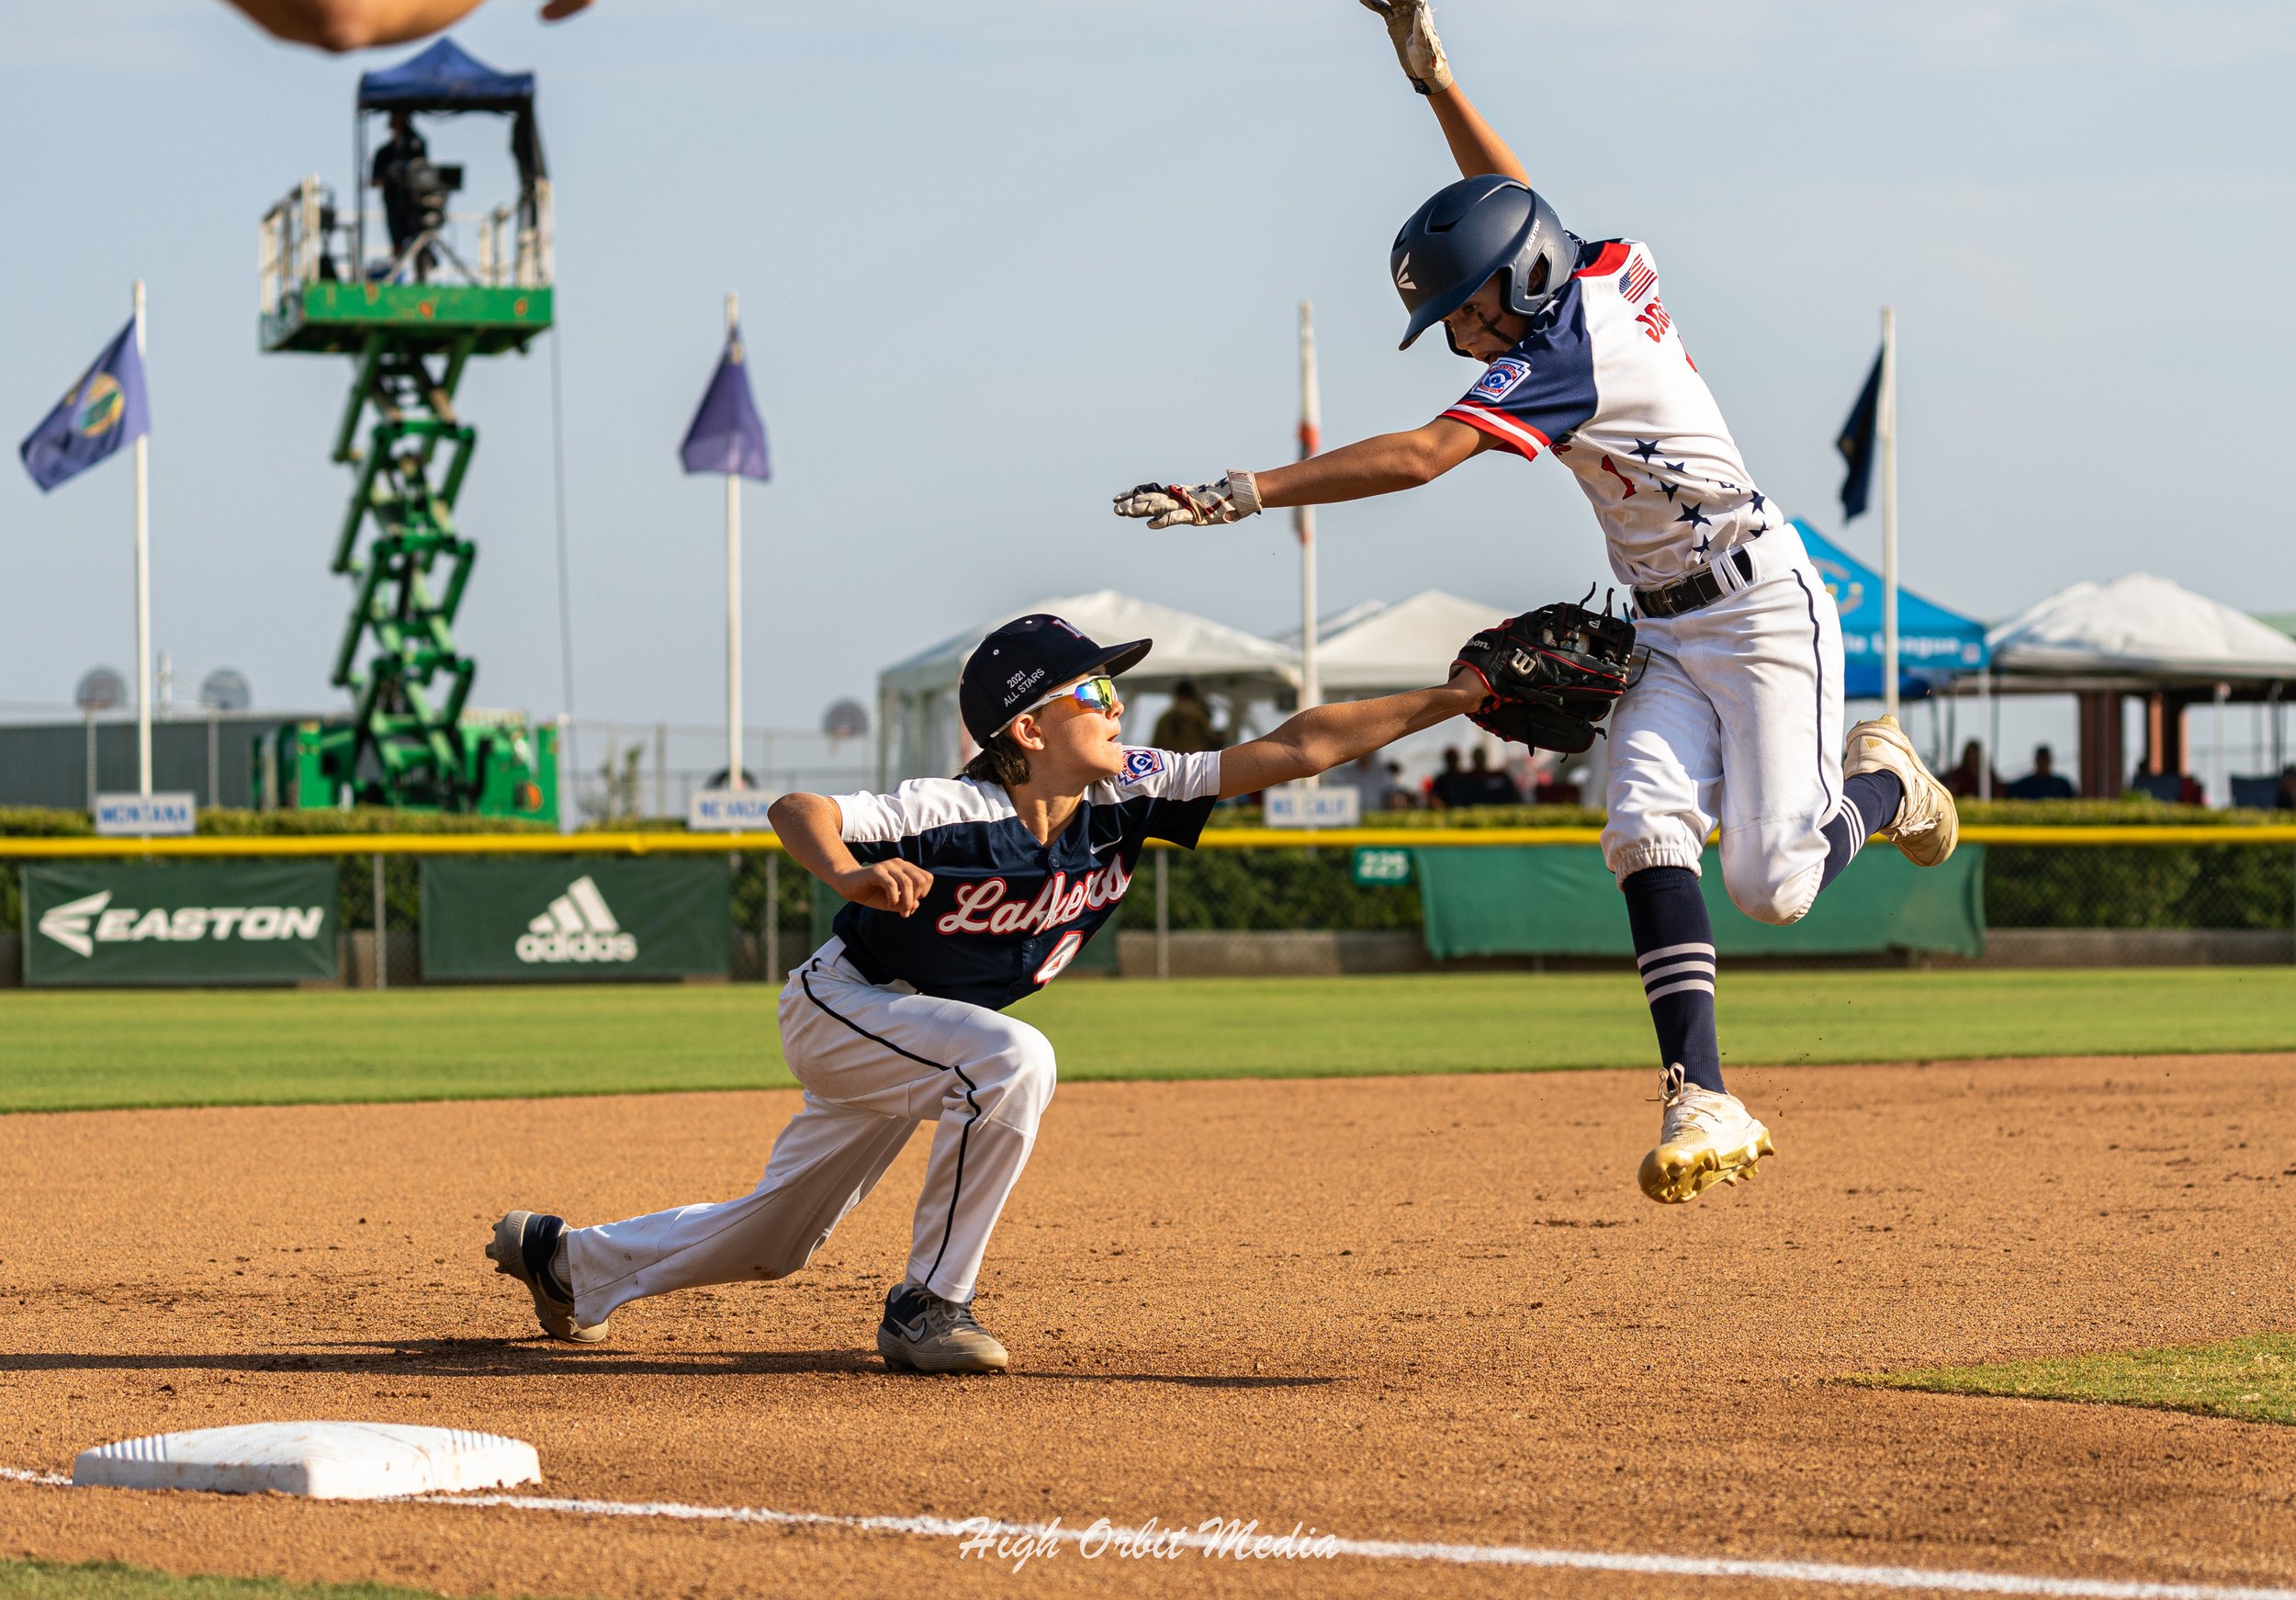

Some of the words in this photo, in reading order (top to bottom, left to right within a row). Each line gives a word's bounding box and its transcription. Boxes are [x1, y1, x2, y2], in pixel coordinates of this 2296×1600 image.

[1525, 219, 1541, 252] EASTON
[1004, 692, 1020, 707] ALL
[1018, 668, 1045, 693] STARS
[1007, 670, 1026, 689] 2021
[936, 852, 1133, 936] Lakers
[95, 907, 324, 941] EASTON
[514, 927, 639, 963] adidas
